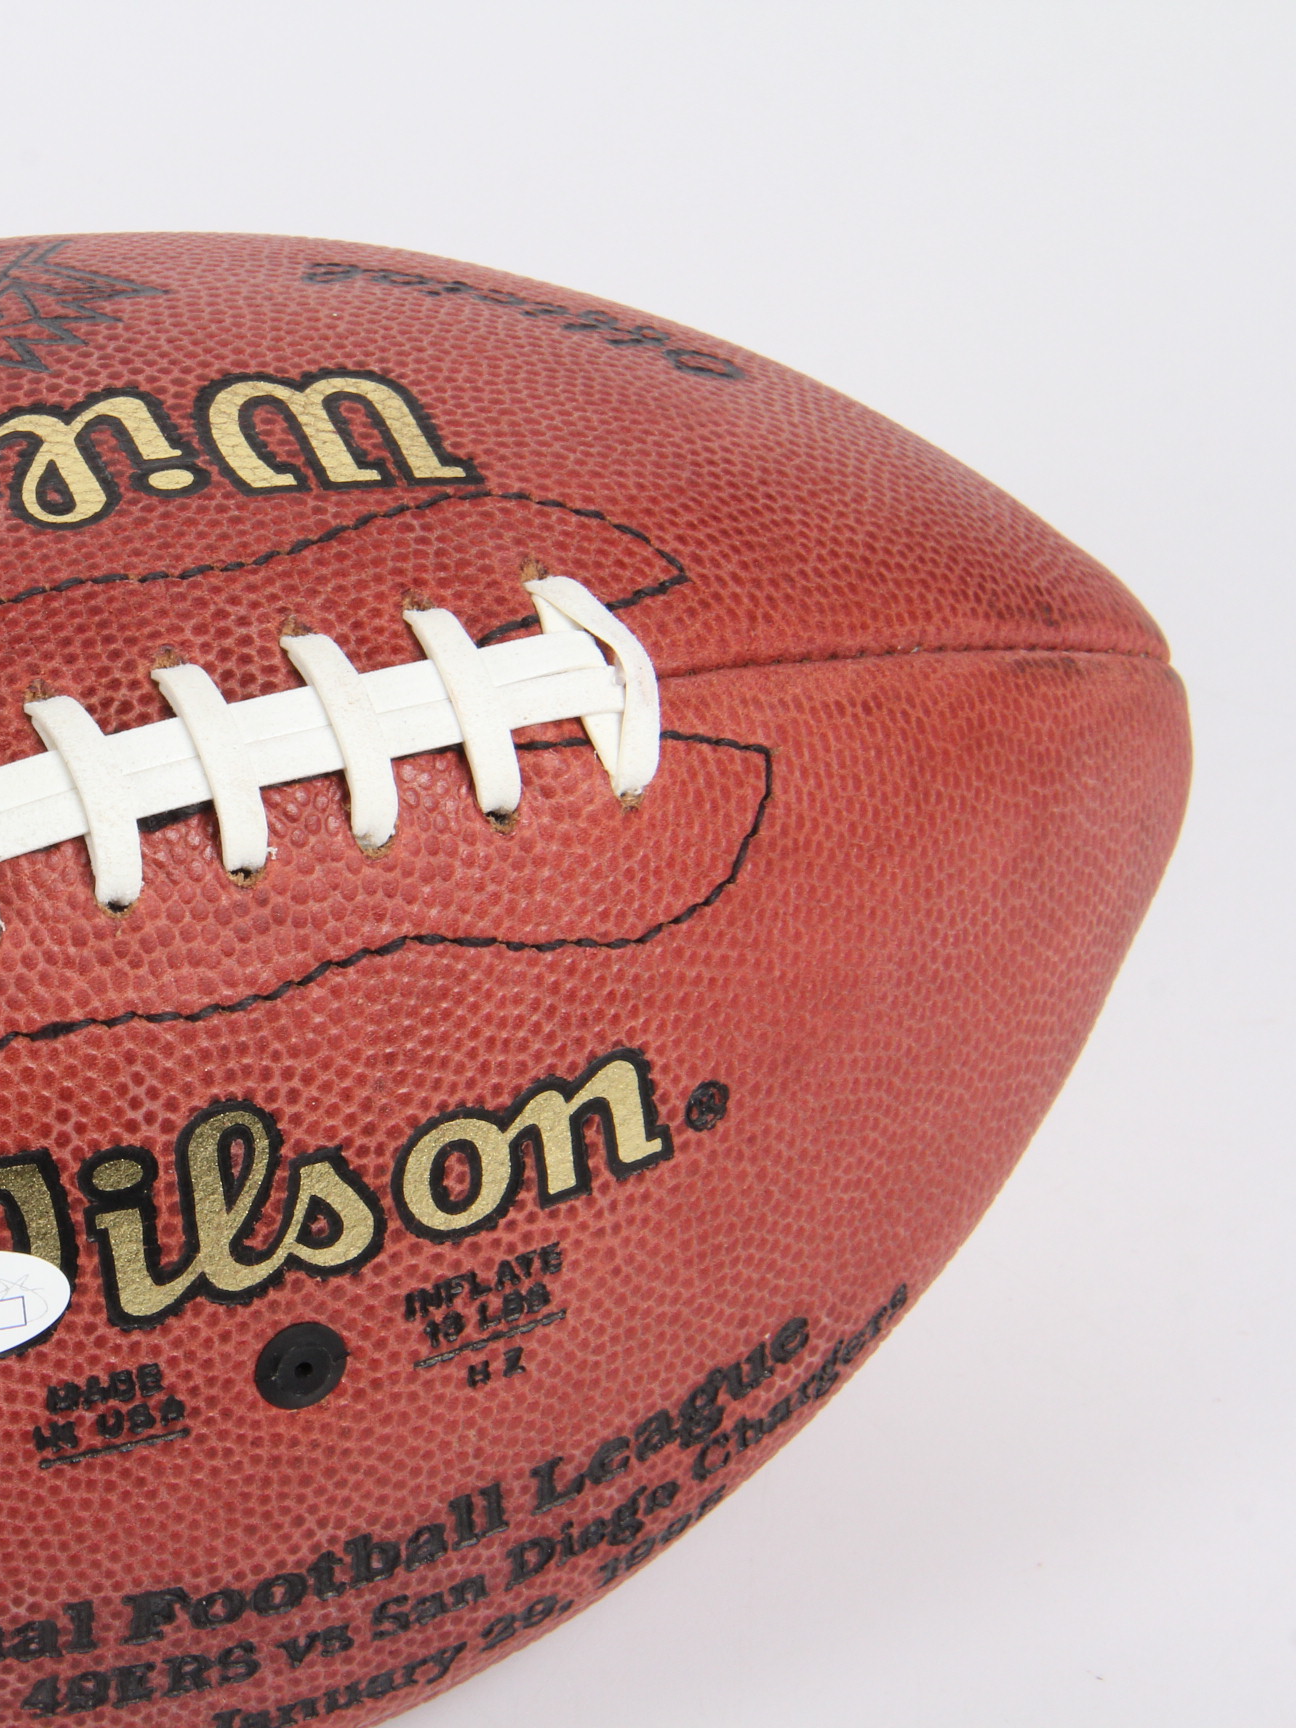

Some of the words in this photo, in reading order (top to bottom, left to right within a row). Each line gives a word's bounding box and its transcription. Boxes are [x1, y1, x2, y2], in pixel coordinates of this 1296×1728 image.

[404, 1241, 563, 1322] INFLATE
[478, 1281, 551, 1331] LBS
[32, 1420, 79, 1453] IN
[96, 1394, 186, 1439] USA
[46, 1363, 165, 1415] MADE
[21, 1641, 261, 1718] 49ERS
[277, 1623, 355, 1669] vs
[371, 1574, 491, 1642] San
[505, 1480, 681, 1591] Diego
[691, 1283, 909, 1482] Chargers
[121, 1483, 509, 1646] Football
[531, 1317, 810, 1516] League
